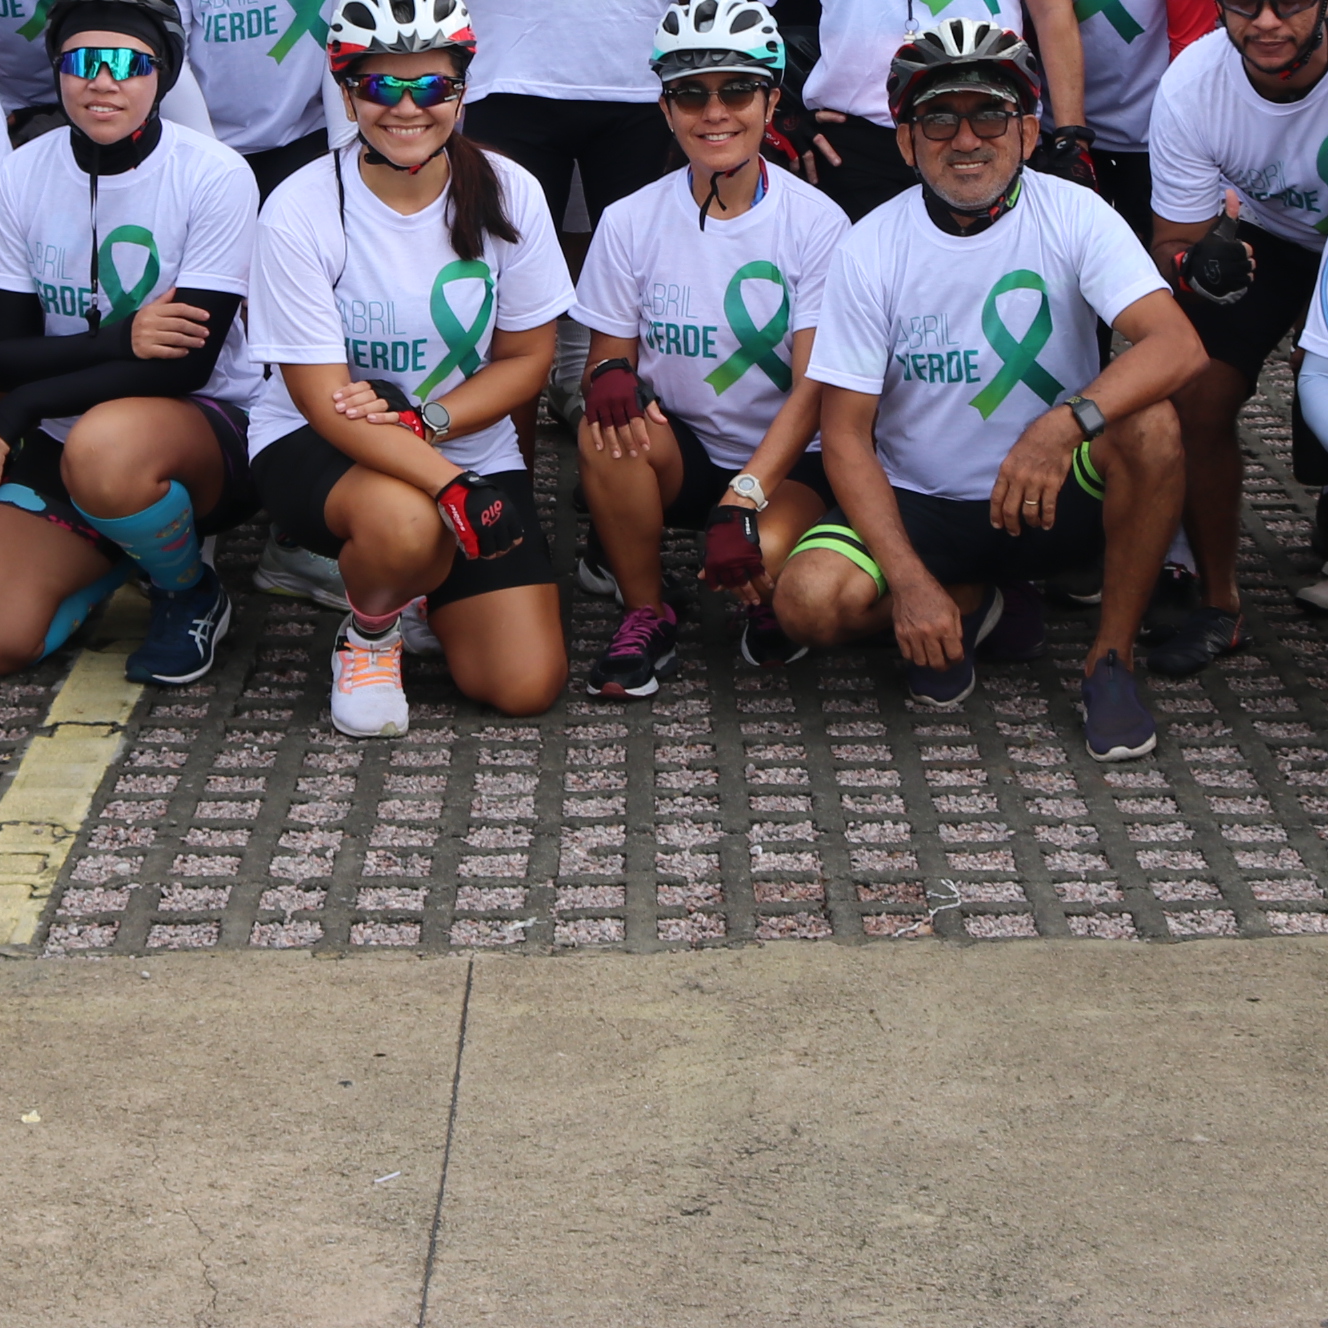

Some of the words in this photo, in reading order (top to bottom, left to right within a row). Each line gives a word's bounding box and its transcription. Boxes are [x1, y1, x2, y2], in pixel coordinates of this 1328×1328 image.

[202, 4, 277, 44] VERDE
[643, 283, 698, 318] ABRIL
[646, 322, 718, 359] VERDE
[895, 313, 960, 347] ABRIL
[896, 349, 982, 386] VERDE
